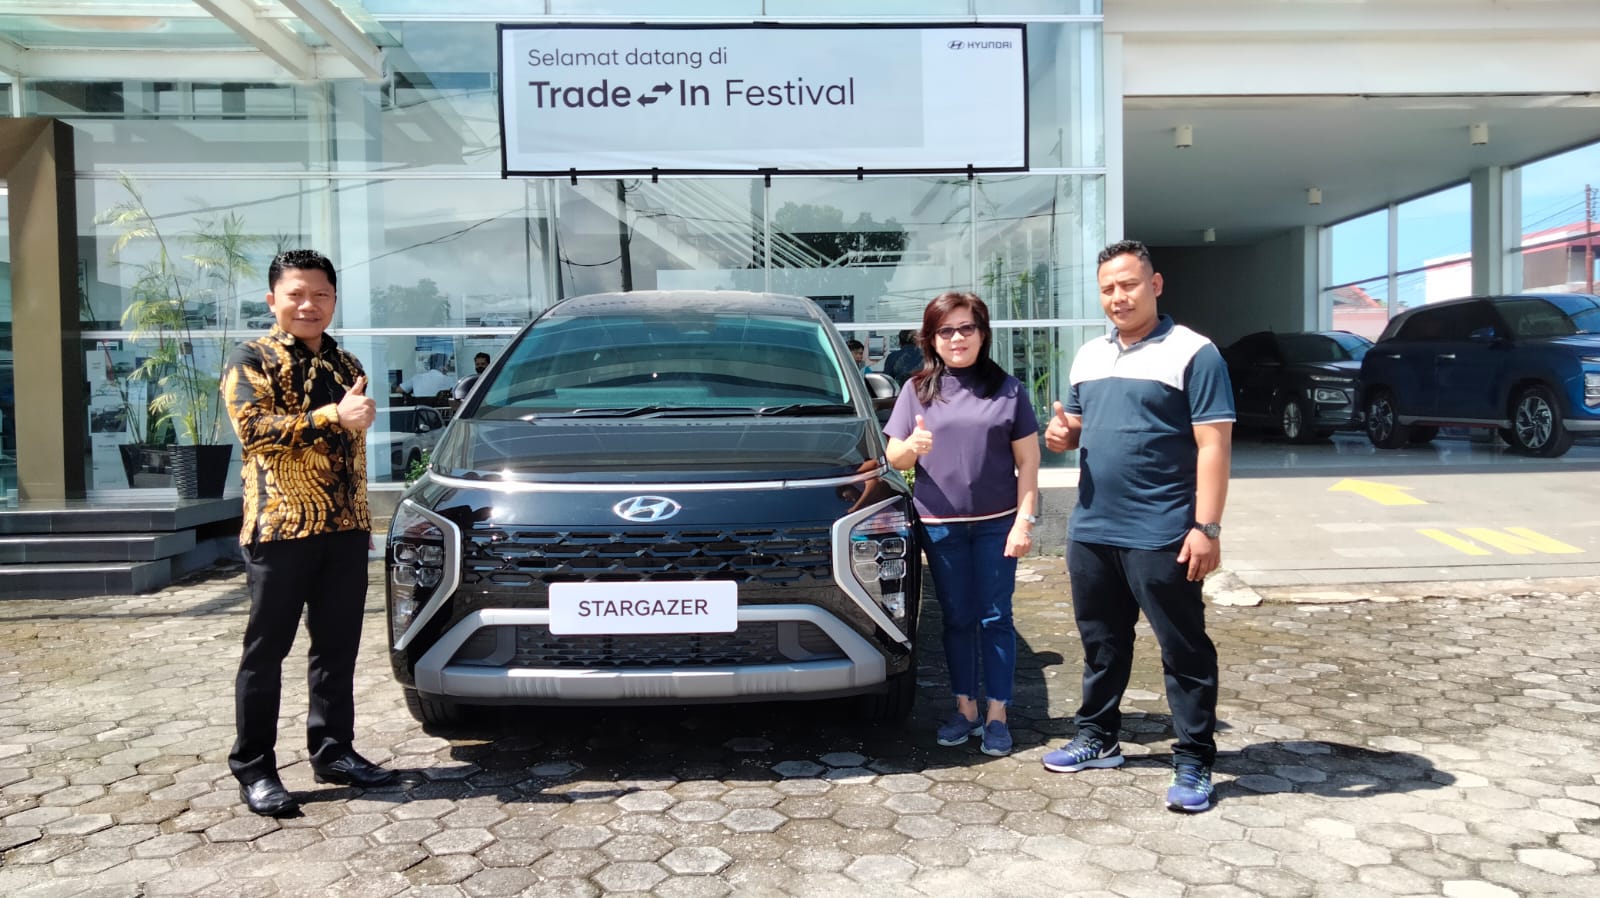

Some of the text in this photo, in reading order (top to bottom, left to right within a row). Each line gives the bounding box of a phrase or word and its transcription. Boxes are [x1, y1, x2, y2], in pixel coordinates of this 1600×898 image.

[967, 41, 1012, 49] HYUNDAI
[527, 47, 728, 69] Selamat datang di
[528, 76, 855, 109] Trade In Festival
[1415, 527, 1586, 556] IN
[577, 599, 709, 617] STARGAZER
